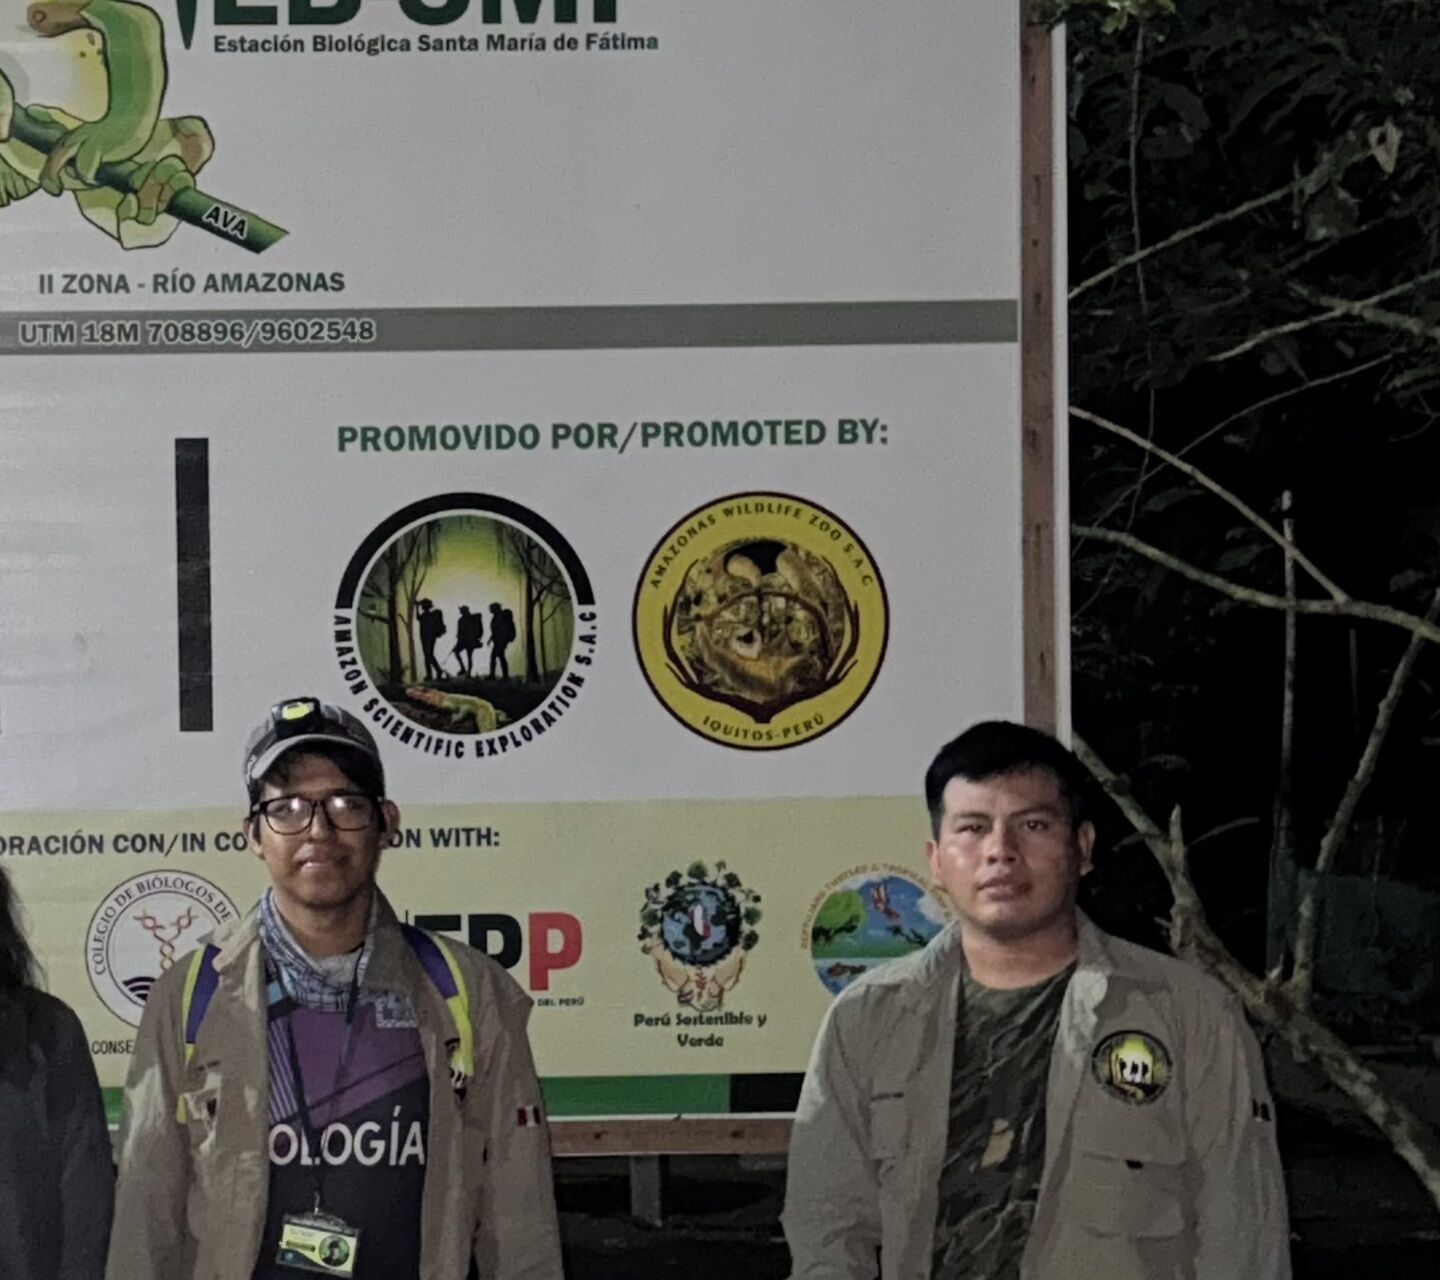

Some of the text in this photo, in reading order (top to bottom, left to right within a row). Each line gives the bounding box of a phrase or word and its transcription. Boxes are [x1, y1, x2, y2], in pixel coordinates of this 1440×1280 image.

[214, 30, 658, 56] Estación Biológica Santa María de Fátima
[206, 206, 248, 238] AVA
[39, 274, 54, 294] II
[62, 273, 130, 294] ZONA
[152, 268, 195, 294] RÍO
[203, 272, 345, 294] AMAZONAS
[20, 320, 375, 348] UTM 18M 708896/9602548
[337, 419, 889, 454] PROMOVIDO POR/PROMOTED BY:
[650, 514, 717, 589] AMAZONAS
[722, 502, 803, 518] WILDLIFE
[809, 514, 842, 541] ZOO
[334, 612, 597, 759] AMAZON SCIENTIFIC EXPLORATION S.A.C
[113, 832, 206, 857] CON/IN
[214, 832, 249, 852] CO
[390, 828, 421, 848] ON
[429, 827, 499, 848] WITH:
[92, 874, 233, 975] COLEGIO DE BIÓLOGOS DE
[634, 1011, 671, 1027] Perú
[757, 1013, 768, 1028] y
[91, 1040, 134, 1055] CONSE
[677, 1033, 724, 1047] Verde
[268, 1105, 426, 1166] OLOGÍA
